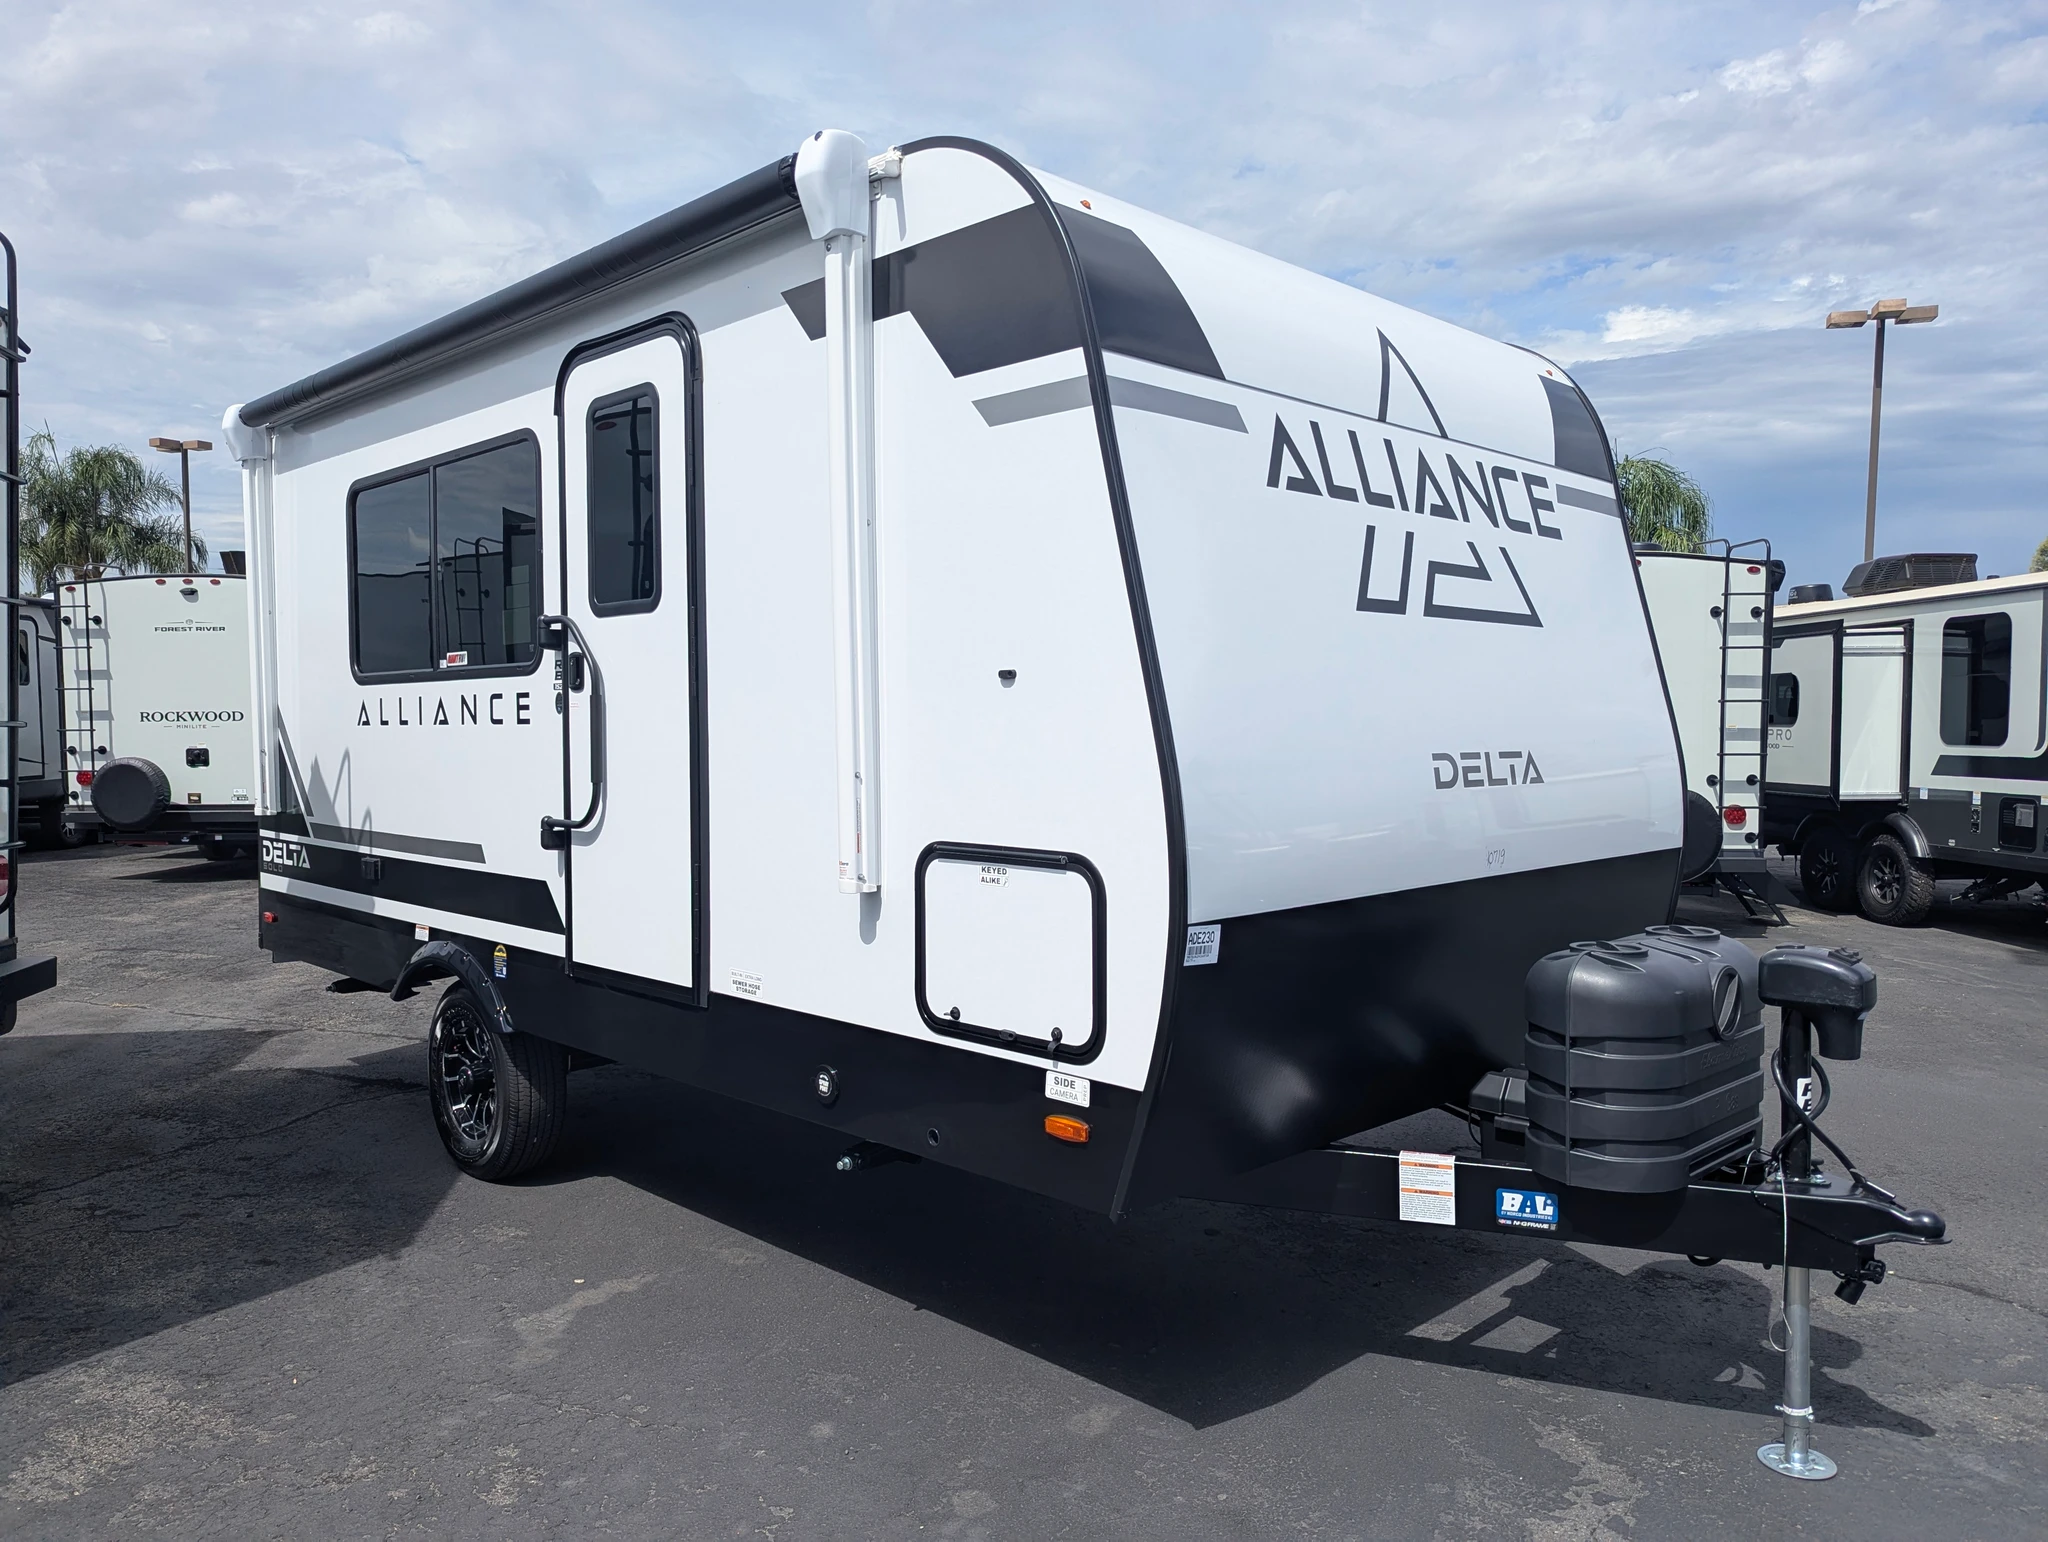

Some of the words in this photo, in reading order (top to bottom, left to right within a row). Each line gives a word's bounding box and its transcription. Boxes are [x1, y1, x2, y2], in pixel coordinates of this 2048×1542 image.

[1266, 412, 1563, 541] ALLIANCE
[357, 692, 531, 727] ALLIANCE
[139, 711, 244, 723] ROCKWOOD
[1431, 750, 1545, 790] DELTA
[262, 840, 311, 869] DELTA
[263, 862, 283, 873] SOLO
[981, 865, 1008, 875] KEYED
[980, 876, 1001, 885] ALIKE
[1188, 931, 1215, 945] ADE230
[732, 979, 748, 987] SEWER
[748, 982, 761, 991] HOSE
[736, 986, 757, 995] STORAGE
[1053, 1076, 1076, 1090] SIDE
[1049, 1087, 1079, 1102] CAMERA
[1501, 1192, 1554, 1216] BAL
